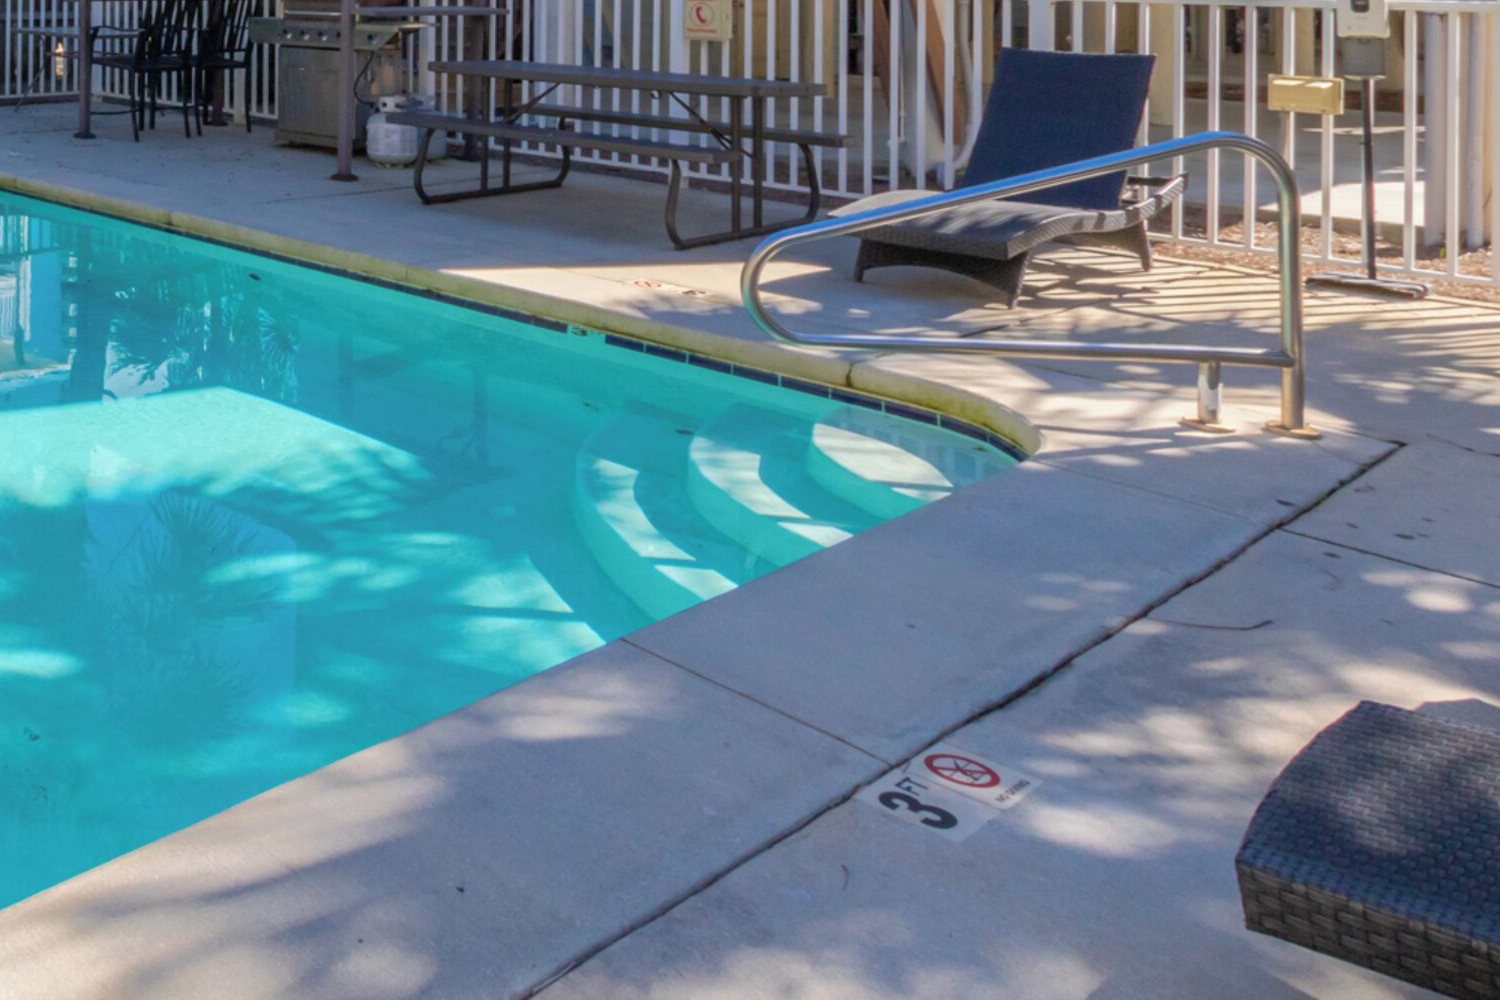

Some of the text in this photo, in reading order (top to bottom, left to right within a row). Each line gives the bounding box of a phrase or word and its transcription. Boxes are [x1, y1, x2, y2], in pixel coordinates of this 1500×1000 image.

[878, 776, 958, 830] 3 FT
[995, 779, 1031, 803] NO DIVING
